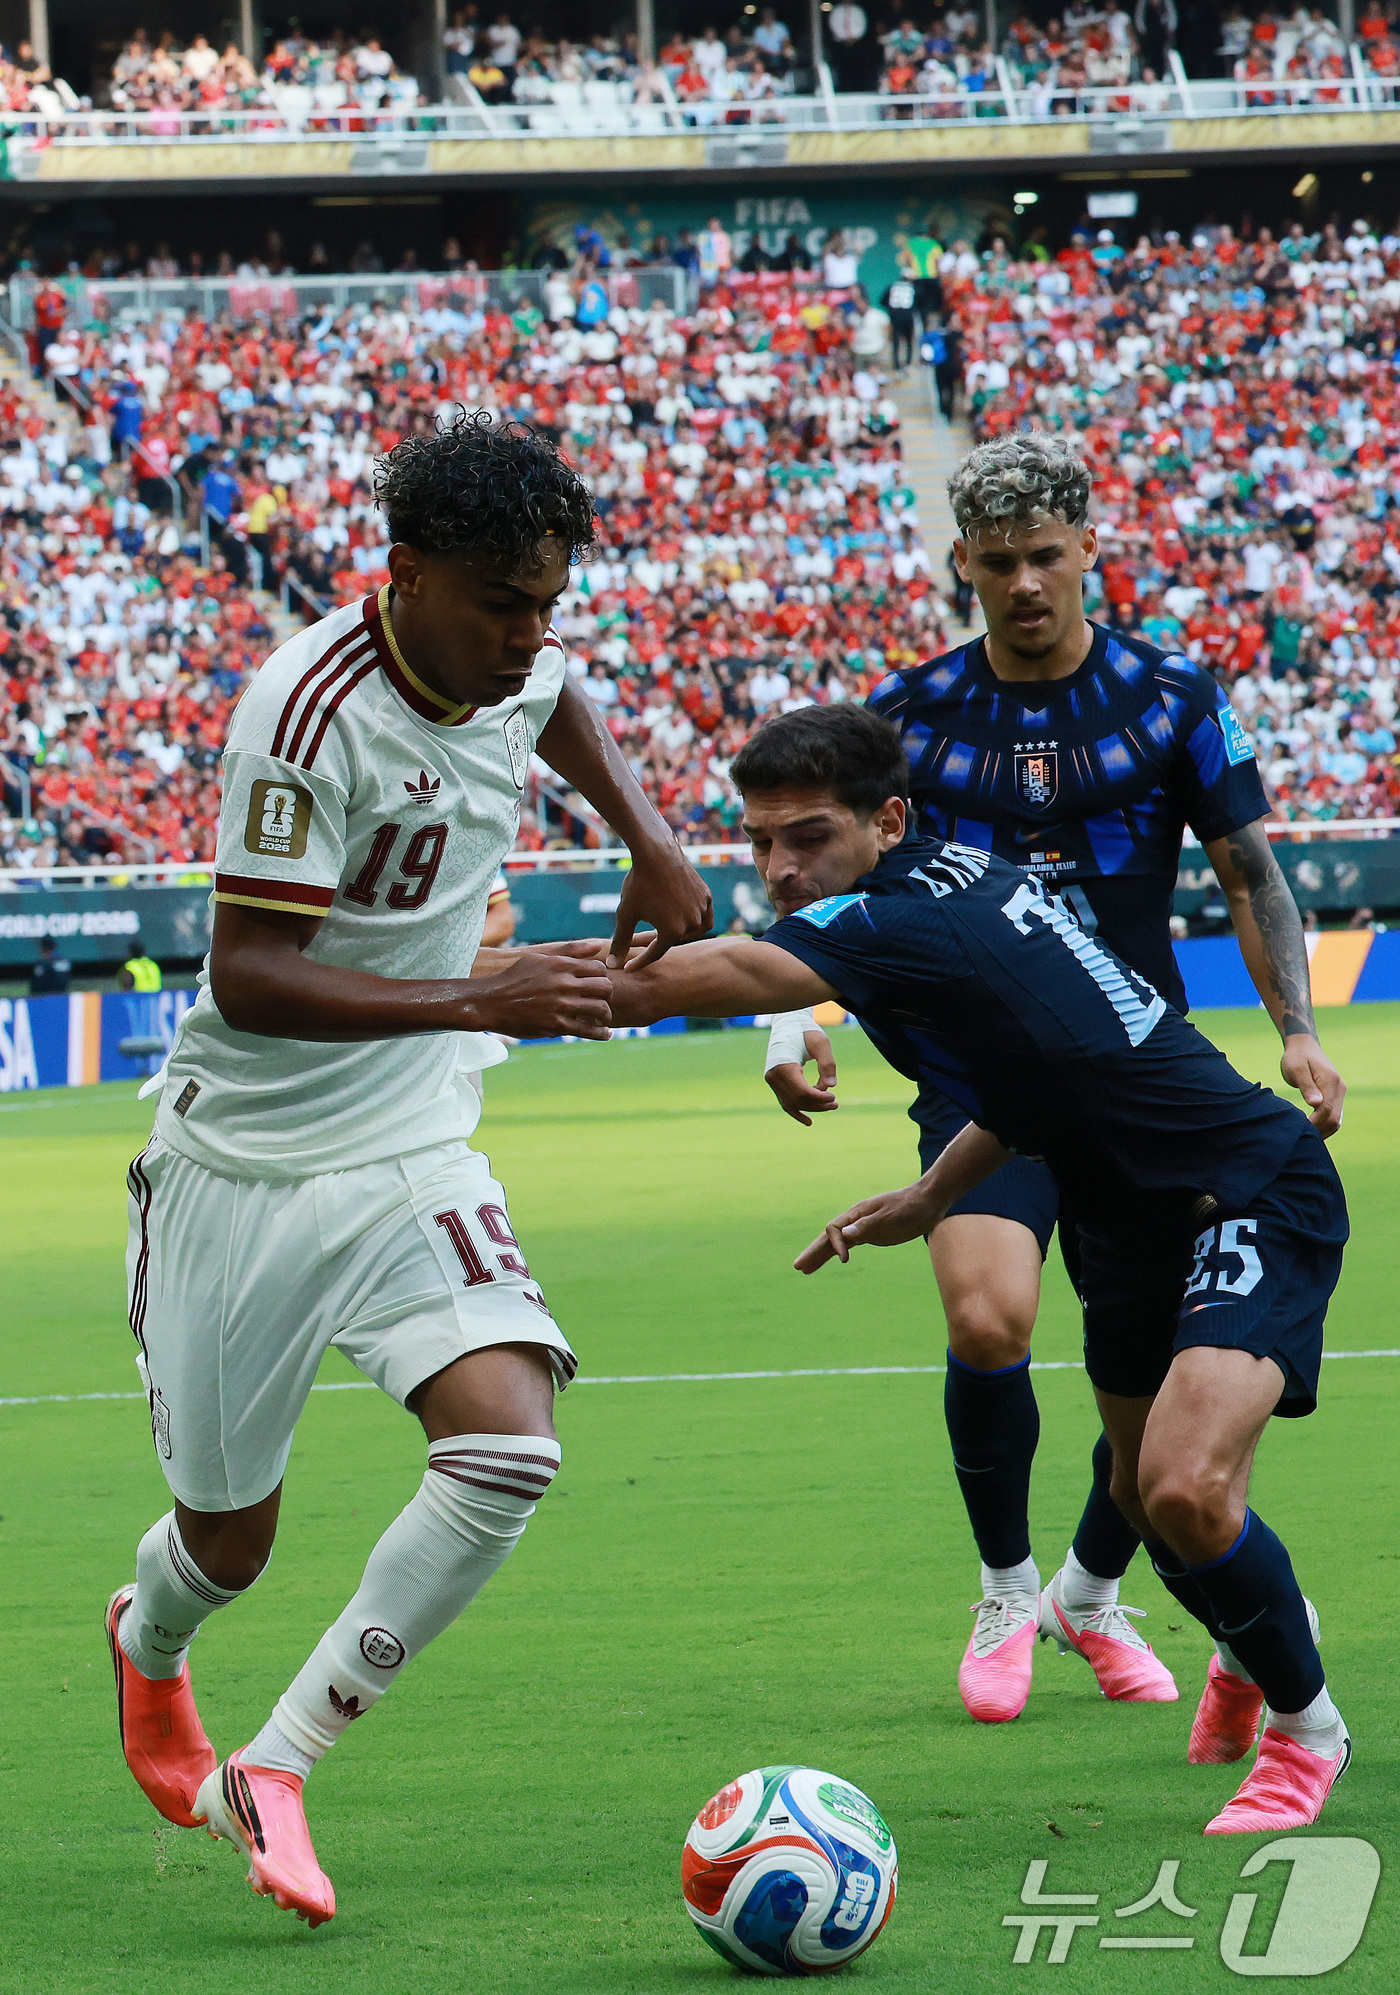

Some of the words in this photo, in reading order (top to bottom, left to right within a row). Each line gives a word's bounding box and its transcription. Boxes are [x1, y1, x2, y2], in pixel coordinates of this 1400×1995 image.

[734, 198, 812, 225] FIFA
[260, 835, 279, 843] WORLD
[269, 825, 284, 833] FIFA
[258, 841, 291, 853] 2026
[343, 822, 449, 910] 19
[47, 912, 80, 936] CUP
[121, 990, 190, 1077] VIS
[433, 1203, 530, 1287] 19
[1183, 1219, 1264, 1300] 25
